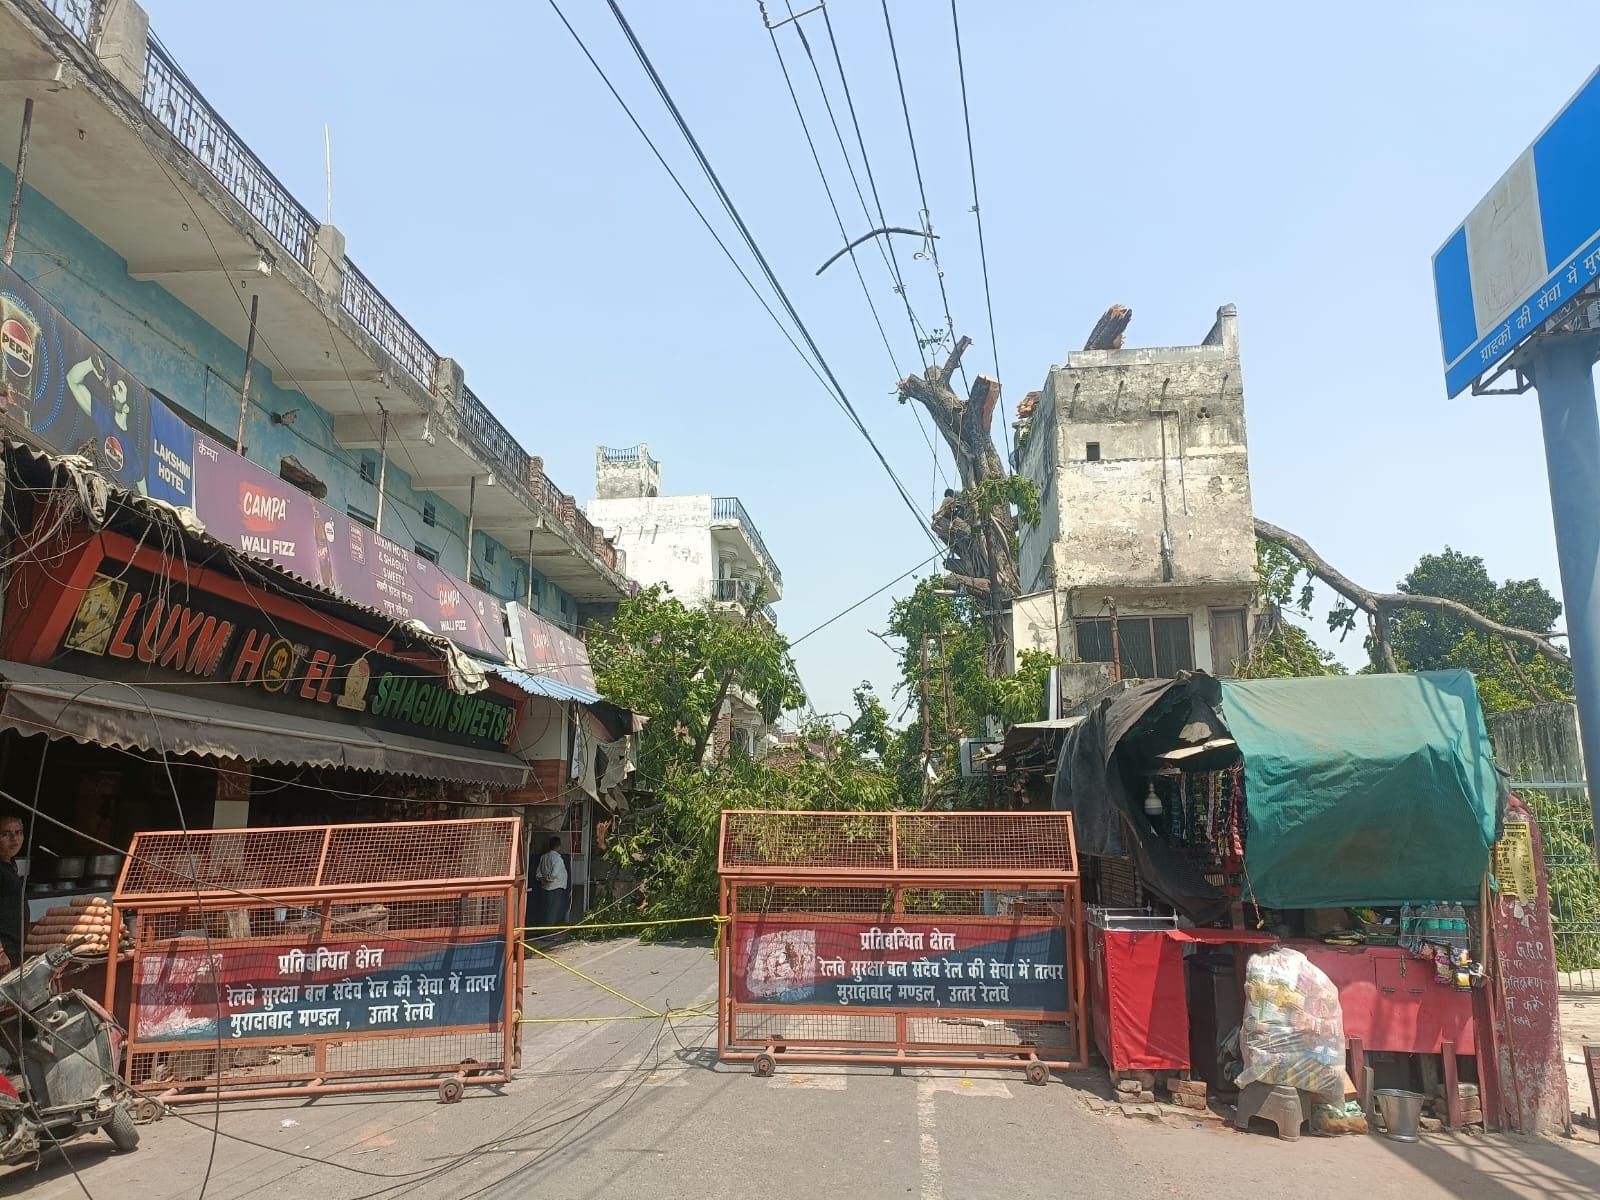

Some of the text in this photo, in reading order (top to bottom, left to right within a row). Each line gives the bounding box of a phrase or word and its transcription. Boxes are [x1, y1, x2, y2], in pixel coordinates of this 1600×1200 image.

[1480, 321, 1512, 363] ग्राहकों
[1515, 305, 1532, 329] की
[1537, 282, 1562, 310] सेवा
[1566, 262, 1578, 284] में
[2, 333, 33, 364] PEPSI
[153, 439, 191, 480] LAKSHMI
[158, 462, 187, 495] HOTEL
[243, 491, 287, 522] CAMPA
[241, 535, 271, 555] WALI
[272, 538, 296, 557] FIZZ
[440, 590, 460, 608] CAMPA
[371, 671, 507, 742] SHAGUN SWEETS
[818, 956, 1064, 982] रेलवे सुरक्षा बल सदैव रेल की सेवा में तत्पर
[226, 971, 497, 1010] रेलवे सुरक्षा बल सदैव रेल की सेवा में तत्पर
[837, 985, 894, 1005] मुरादाबाद
[948, 985, 976, 1002] उत्तर
[979, 981, 1010, 1002] रेलवे
[230, 1010, 294, 1038] मुरादाबाद
[368, 1005, 399, 1024] उत्तर
[402, 998, 435, 1021] रेलवे
